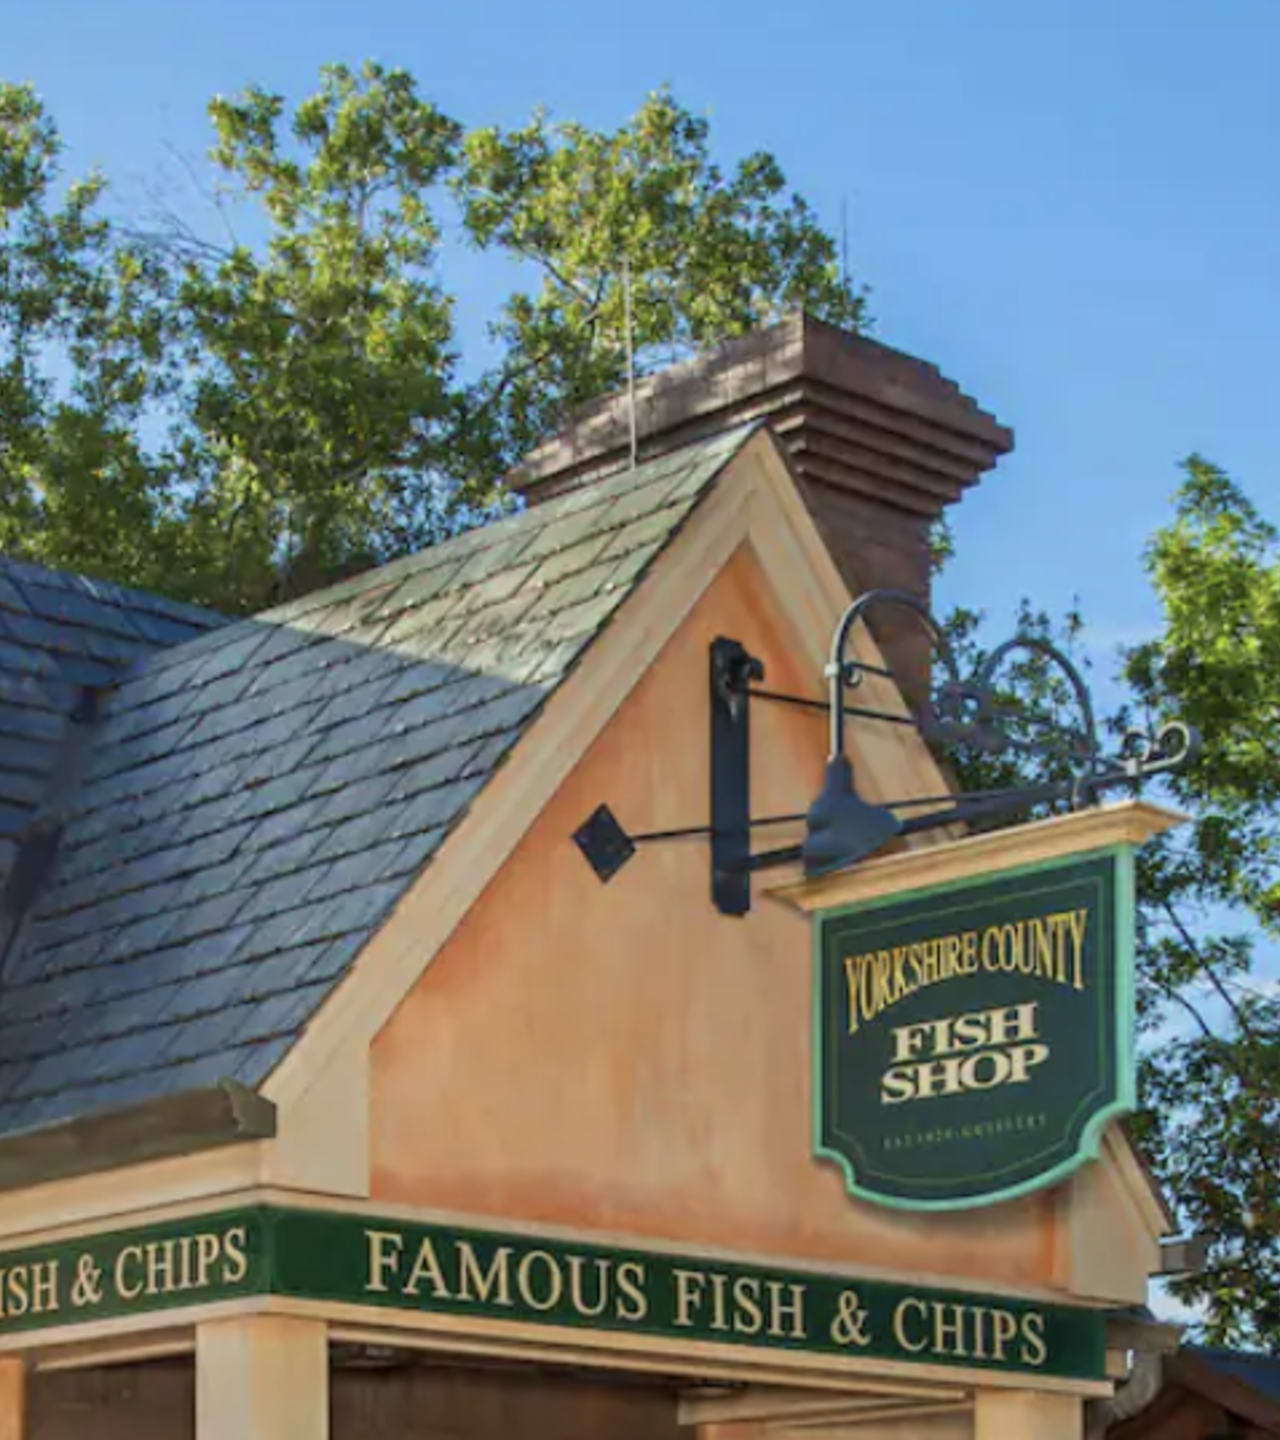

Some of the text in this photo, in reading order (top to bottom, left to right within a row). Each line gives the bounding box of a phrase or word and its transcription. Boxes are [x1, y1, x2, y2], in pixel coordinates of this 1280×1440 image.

[844, 908, 1088, 1034] YORKSHIRE COUNTY
[891, 1001, 1039, 1064] FISH
[880, 1043, 1050, 1105] SHOP
[71, 1253, 103, 1306] &
[113, 1226, 249, 1299] CHIPS
[363, 1228, 1048, 1367] FAMOUS FISH & CHIPS
